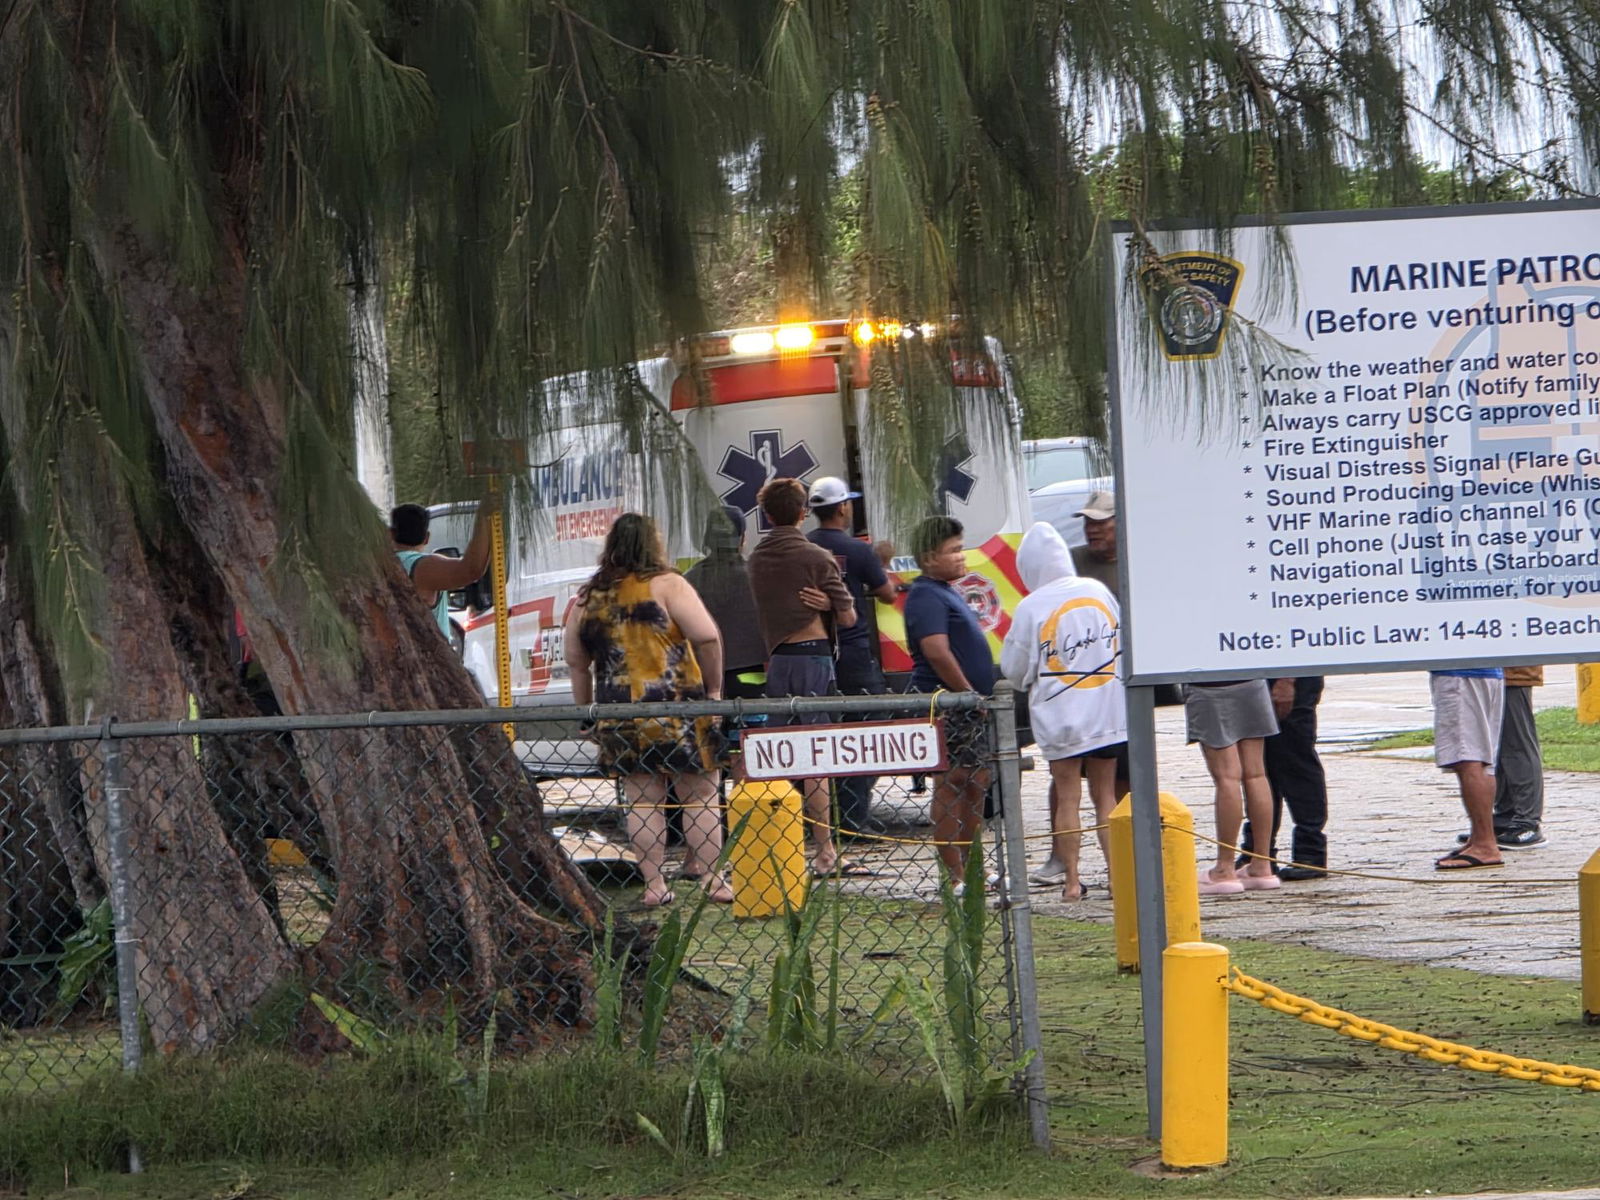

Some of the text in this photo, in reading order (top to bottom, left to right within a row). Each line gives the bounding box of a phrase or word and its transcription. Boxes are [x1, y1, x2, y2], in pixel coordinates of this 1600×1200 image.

[1350, 259, 1488, 293] MARINE
[1305, 307, 1418, 341] (Before
[1427, 299, 1575, 328] venturing
[1261, 365, 1321, 382] Know
[1328, 361, 1361, 378] the
[1368, 357, 1452, 376] weather
[1460, 353, 1499, 371] and
[1506, 351, 1566, 369] water
[1263, 373, 1600, 407] Make a Float Plan (Notify family
[1262, 414, 1338, 433] Always
[1346, 410, 1401, 430] carry
[1408, 404, 1472, 424] USCG
[1479, 399, 1581, 425] approved
[1264, 432, 1449, 457] Fire Extinguisher
[1264, 461, 1330, 481] Visual
[1338, 460, 1426, 479] Distress
[1433, 452, 1500, 476] Signal
[1508, 451, 1569, 473] (Flare
[1266, 486, 1336, 507] Sound
[1343, 482, 1454, 502] Producing
[1461, 479, 1534, 497] Device
[1267, 512, 1312, 531] VHF
[1319, 510, 1391, 529] Marine
[1398, 506, 1453, 525] radio
[1460, 500, 1545, 520] channel
[1552, 499, 1576, 517] 16
[1269, 537, 1309, 556] Cell
[1317, 536, 1384, 558] phone
[1391, 532, 1444, 554] (Just
[1451, 529, 1470, 548] in
[1477, 531, 1527, 547] case
[1534, 527, 1583, 547] your
[1270, 549, 1599, 584] Navigational Lights (Starboard
[1271, 586, 1409, 610] Inexperience
[1416, 582, 1519, 603] swimmer,
[1525, 578, 1557, 596] for
[1218, 631, 1281, 651] Note:
[1290, 626, 1366, 648] Public
[1374, 625, 1430, 644] Law:
[1438, 618, 1502, 640] 14-48
[755, 731, 928, 769] NO FISHING
